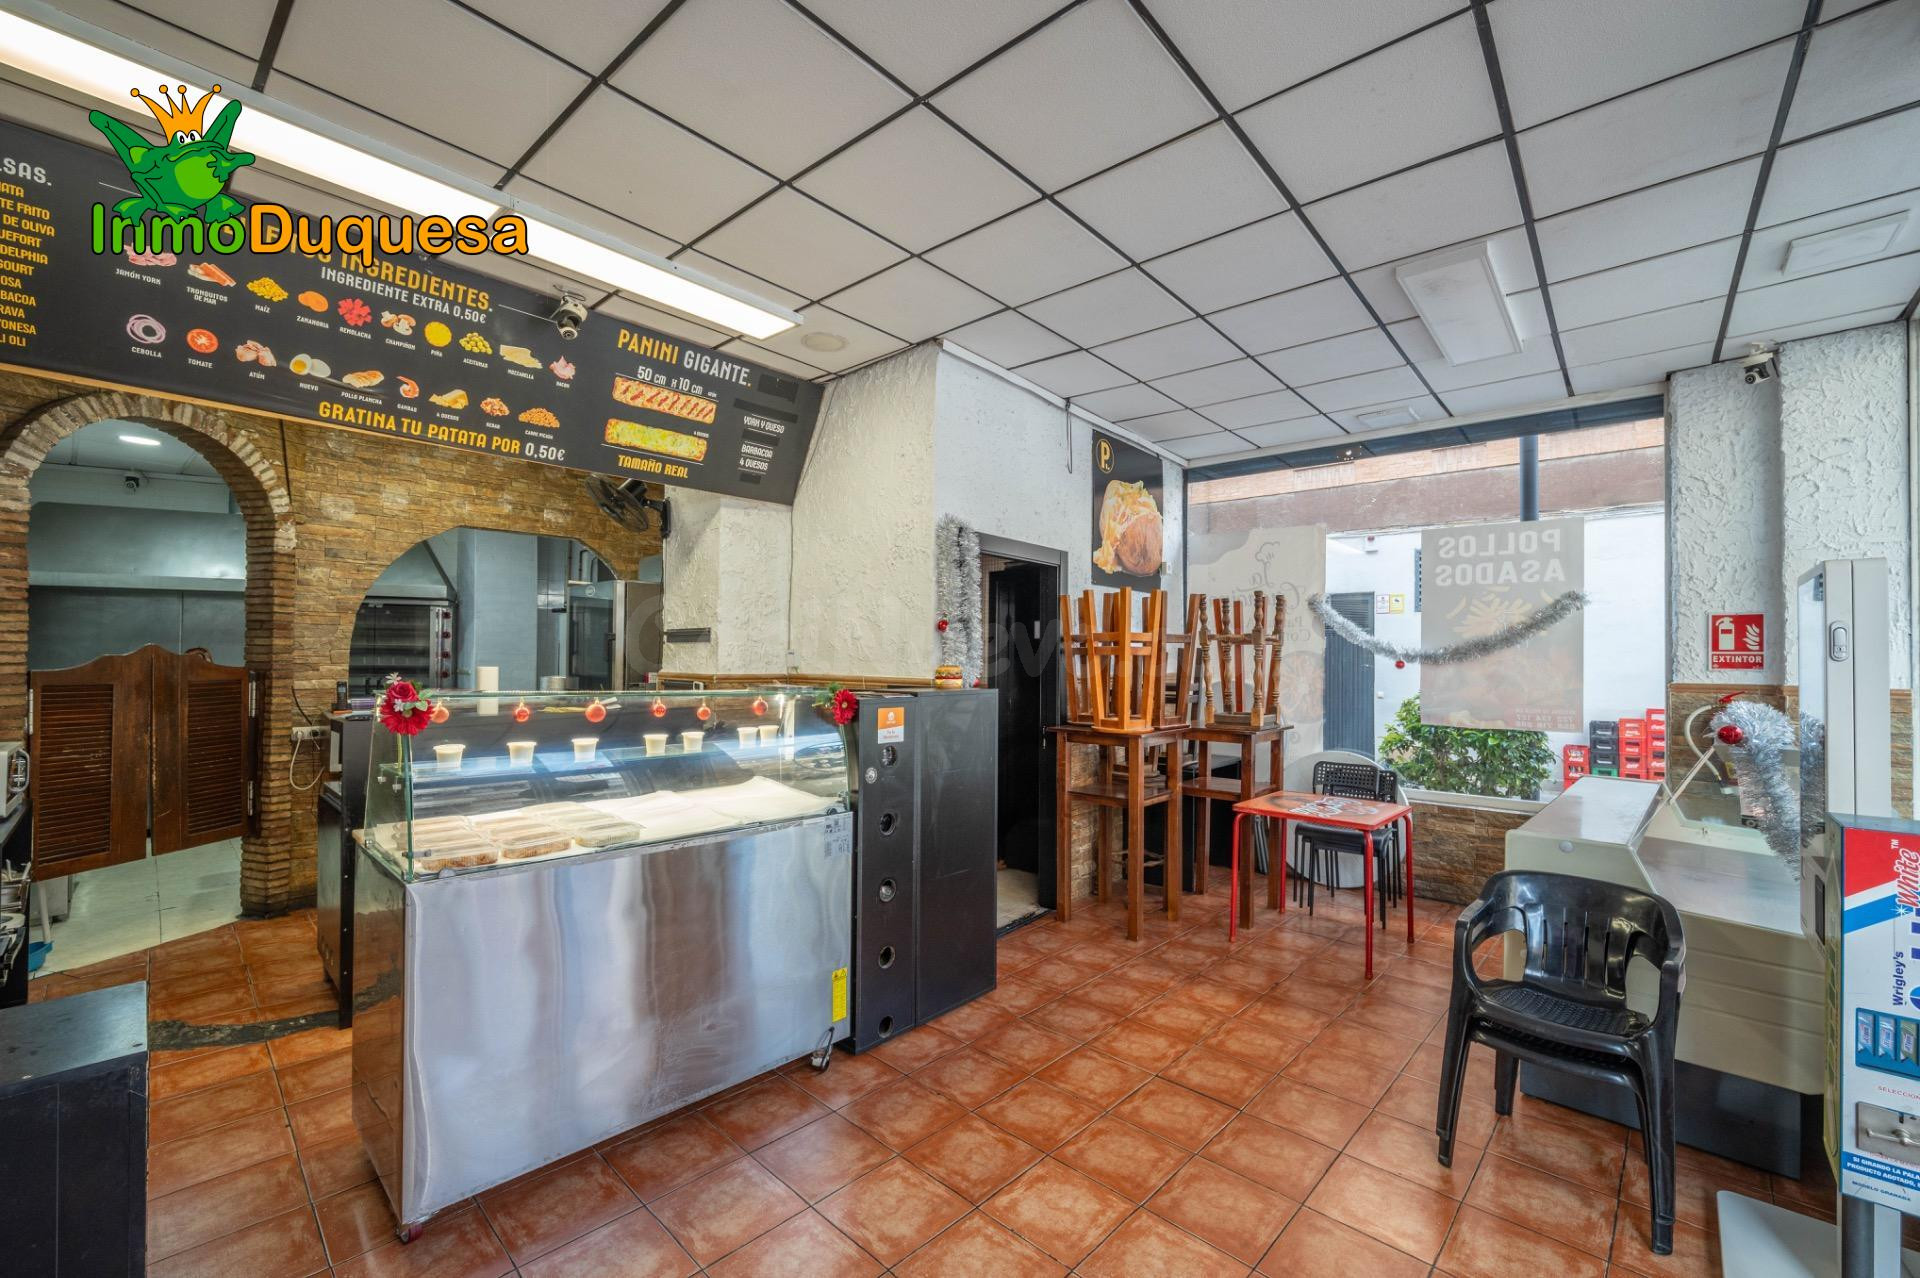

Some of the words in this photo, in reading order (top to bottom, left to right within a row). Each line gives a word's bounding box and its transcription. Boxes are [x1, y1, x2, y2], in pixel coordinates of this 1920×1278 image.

[0, 157, 52, 187] SAS.
[0, 182, 25, 198] ATA
[17, 202, 50, 220] FRITO
[3, 214, 19, 227] DE
[21, 219, 55, 237] OLIVA
[321, 266, 409, 303] INGREDIENTE
[412, 292, 450, 315] EXTRA
[452, 306, 487, 324] 0,50€
[0, 319, 37, 335] ONESA
[9, 335, 26, 347] OLI
[187, 358, 213, 369] TOMATE
[617, 328, 679, 365] PANINI
[683, 349, 752, 387] GIGANTE.
[637, 365, 653, 381] 50
[678, 377, 690, 392] 10
[319, 401, 397, 432] GRATINA
[400, 417, 422, 436] TU
[427, 423, 487, 449] PATATA
[491, 435, 521, 455] POR
[524, 442, 566, 462] 0,50€
[765, 422, 785, 434] QUESO
[618, 454, 662, 474] TAMAÑO
[664, 463, 688, 479] REAL
[1712, 655, 1762, 663] EXTINTOR
[1894, 848, 1920, 908] White
[1893, 951, 1907, 1006] Wrigley's
